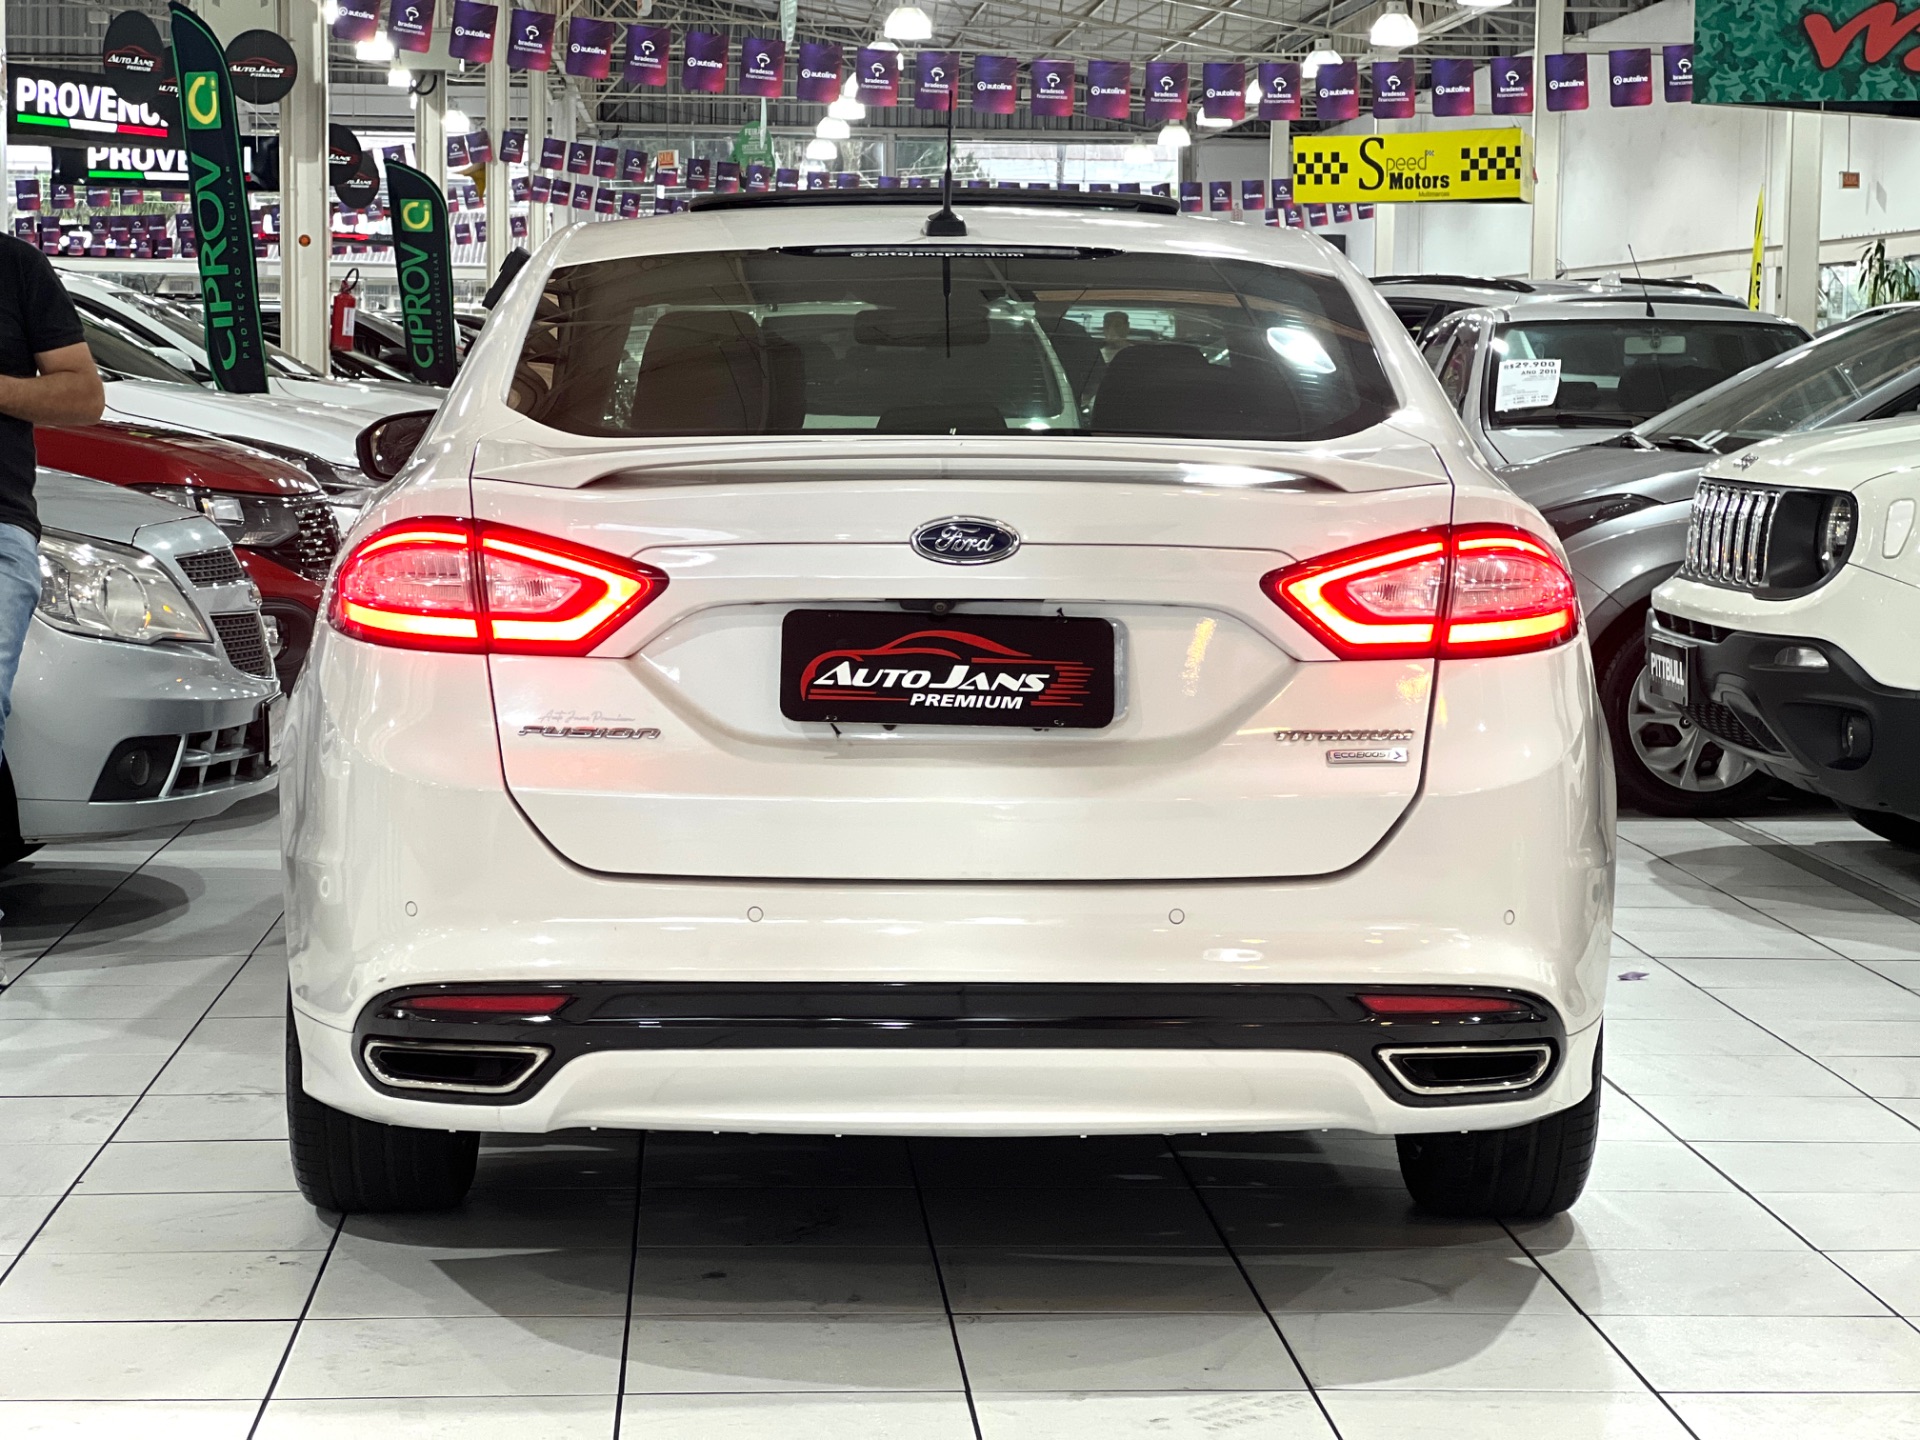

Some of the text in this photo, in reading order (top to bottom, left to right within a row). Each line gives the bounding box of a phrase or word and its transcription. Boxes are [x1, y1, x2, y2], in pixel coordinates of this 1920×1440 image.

[347, 9, 375, 20] autoline
[398, 20, 423, 30] bradesco
[464, 29, 492, 40] autoline
[518, 39, 543, 49] bradesco
[580, 46, 607, 55] autoline
[634, 55, 659, 63] bradesco
[697, 60, 723, 69] autoline
[749, 68, 774, 76] bradesco
[811, 71, 837, 79] autoline
[1559, 80, 1584, 88] autoline
[1622, 75, 1648, 84] autoline
[986, 82, 1012, 90] autoline
[1100, 87, 1126, 95] autoline
[1444, 86, 1470, 94] autoline
[1216, 89, 1241, 97] autoline
[1329, 88, 1354, 96] autoline
[1358, 137, 1427, 190] Speed
[1389, 172, 1450, 190] Motors
[190, 151, 237, 370] CIPROV
[226, 165, 250, 359] PROTEÇÃO VEICULAR
[400, 241, 435, 368] CIPROV
[935, 526, 995, 551] Ford
[909, 693, 1023, 710] PREMIUM
[518, 726, 661, 739] FUSION
[1274, 730, 1414, 741] TITANIUM
